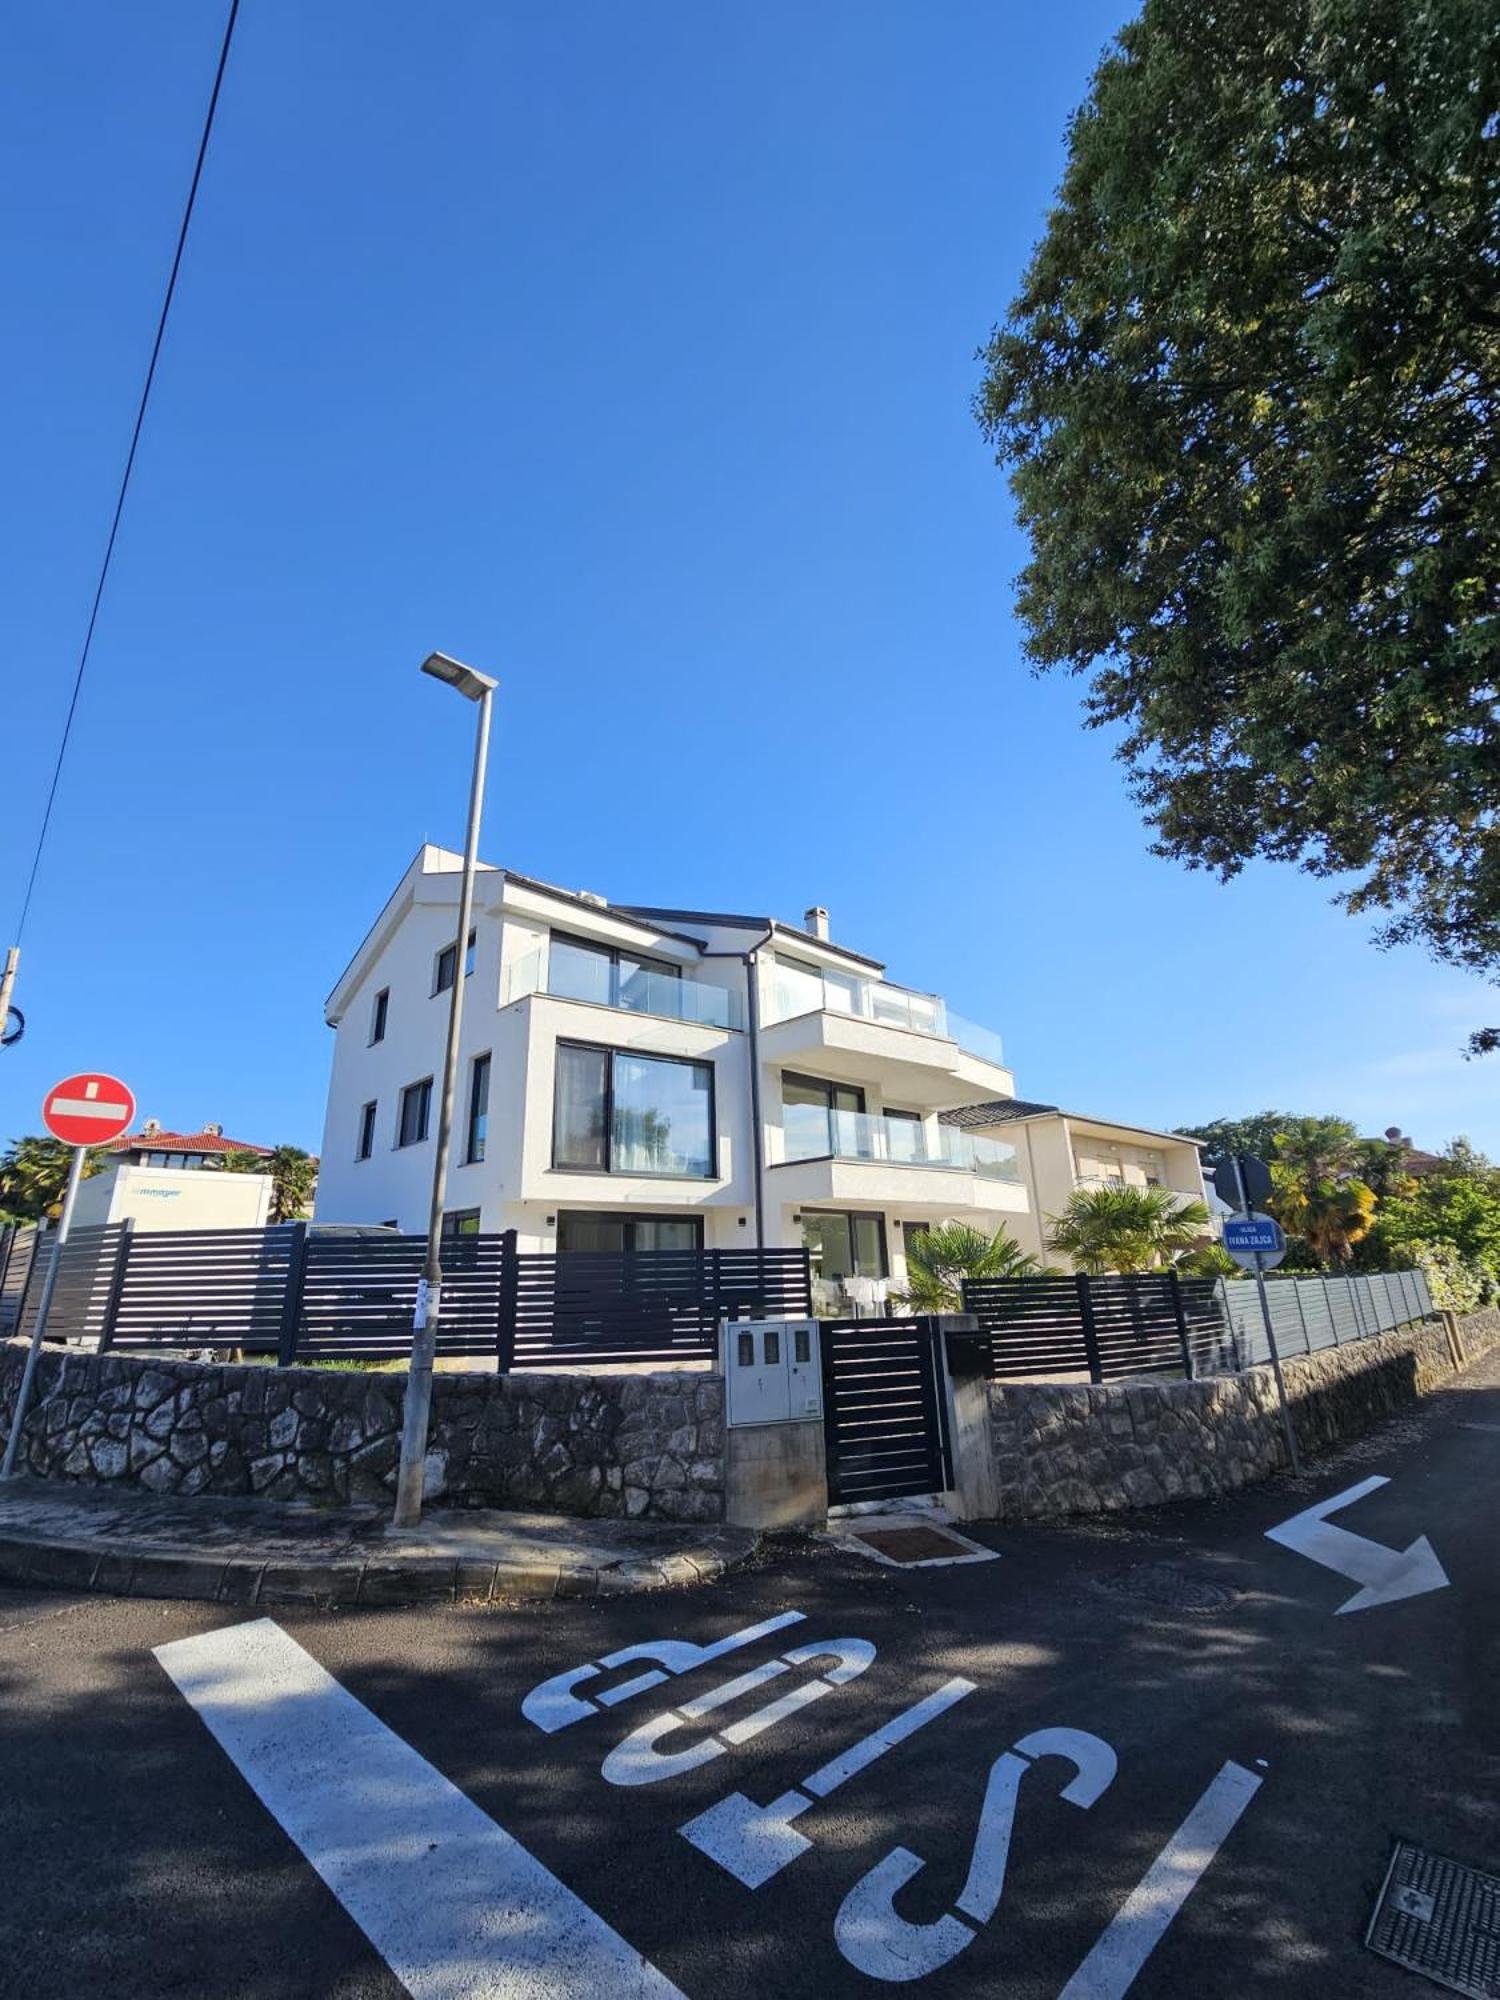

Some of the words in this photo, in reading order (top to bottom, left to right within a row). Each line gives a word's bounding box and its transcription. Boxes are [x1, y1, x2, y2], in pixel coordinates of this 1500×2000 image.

[1228, 1236, 1249, 1246] IVANA
[1250, 1235, 1273, 1245] ZAJCA
[521, 1610, 1118, 1982] STOP
